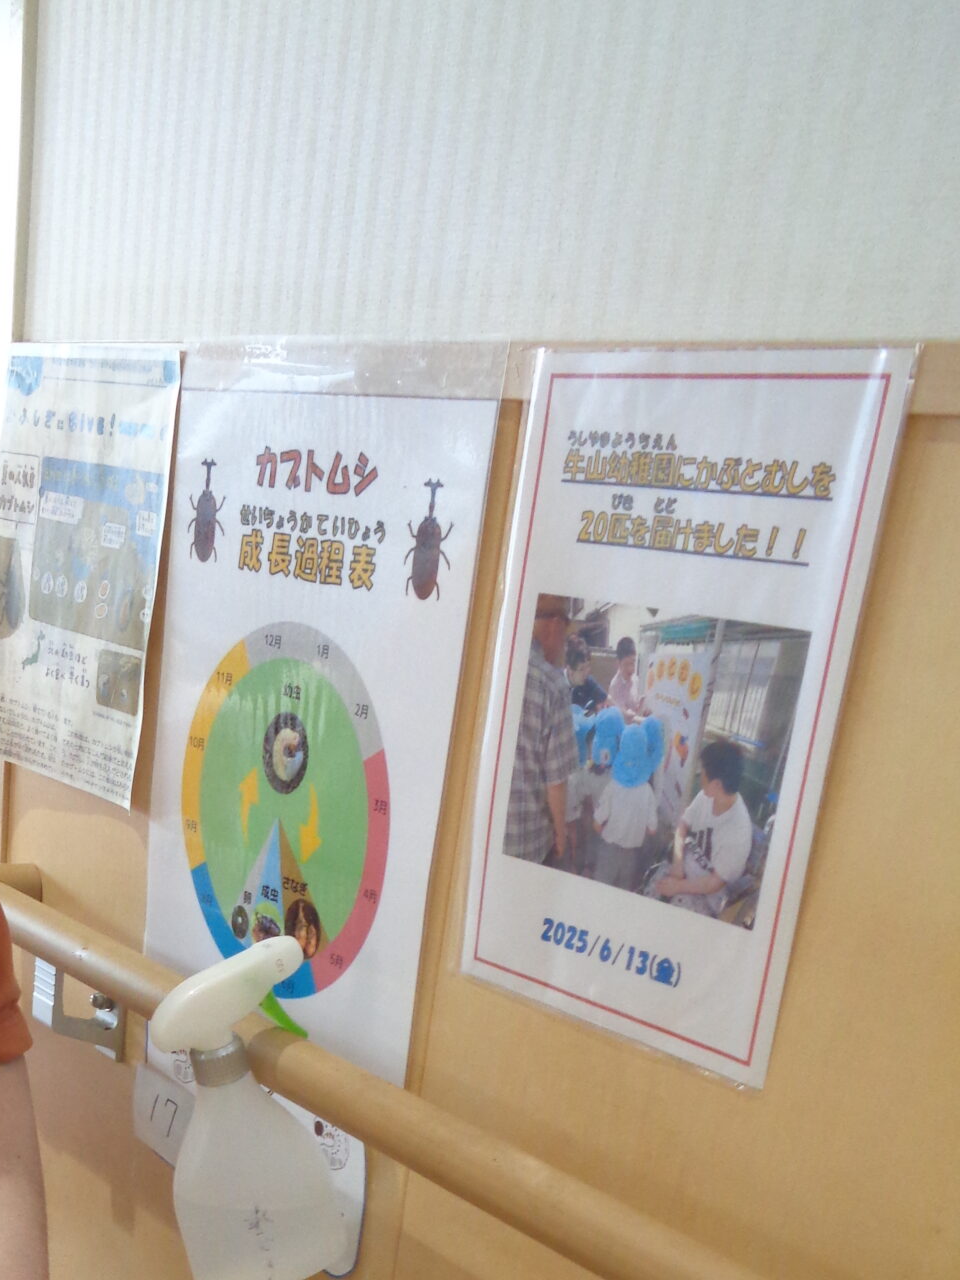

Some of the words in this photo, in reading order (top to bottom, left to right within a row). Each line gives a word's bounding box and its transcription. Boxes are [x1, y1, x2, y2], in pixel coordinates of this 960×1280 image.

[256, 446, 378, 496] カブトムシ
[563, 448, 836, 498] 牛山幼稚園にかぶとむしを
[238, 529, 377, 590] 成長過程表
[264, 634, 282, 649] 12月
[316, 644, 329, 659] 1月
[216, 672, 233, 686] 11月
[283, 682, 302, 700] 幼虫
[354, 704, 369, 719] 2月
[189, 736, 206, 751] 10月
[373, 799, 387, 815] 3月
[262, 885, 279, 903] 成虫
[282, 876, 308, 897] さなぎ
[363, 889, 377, 904] 4月
[541, 917, 681, 988] 2025/6/13(金)
[330, 954, 344, 970] 5月
[150, 1094, 178, 1137] 17
